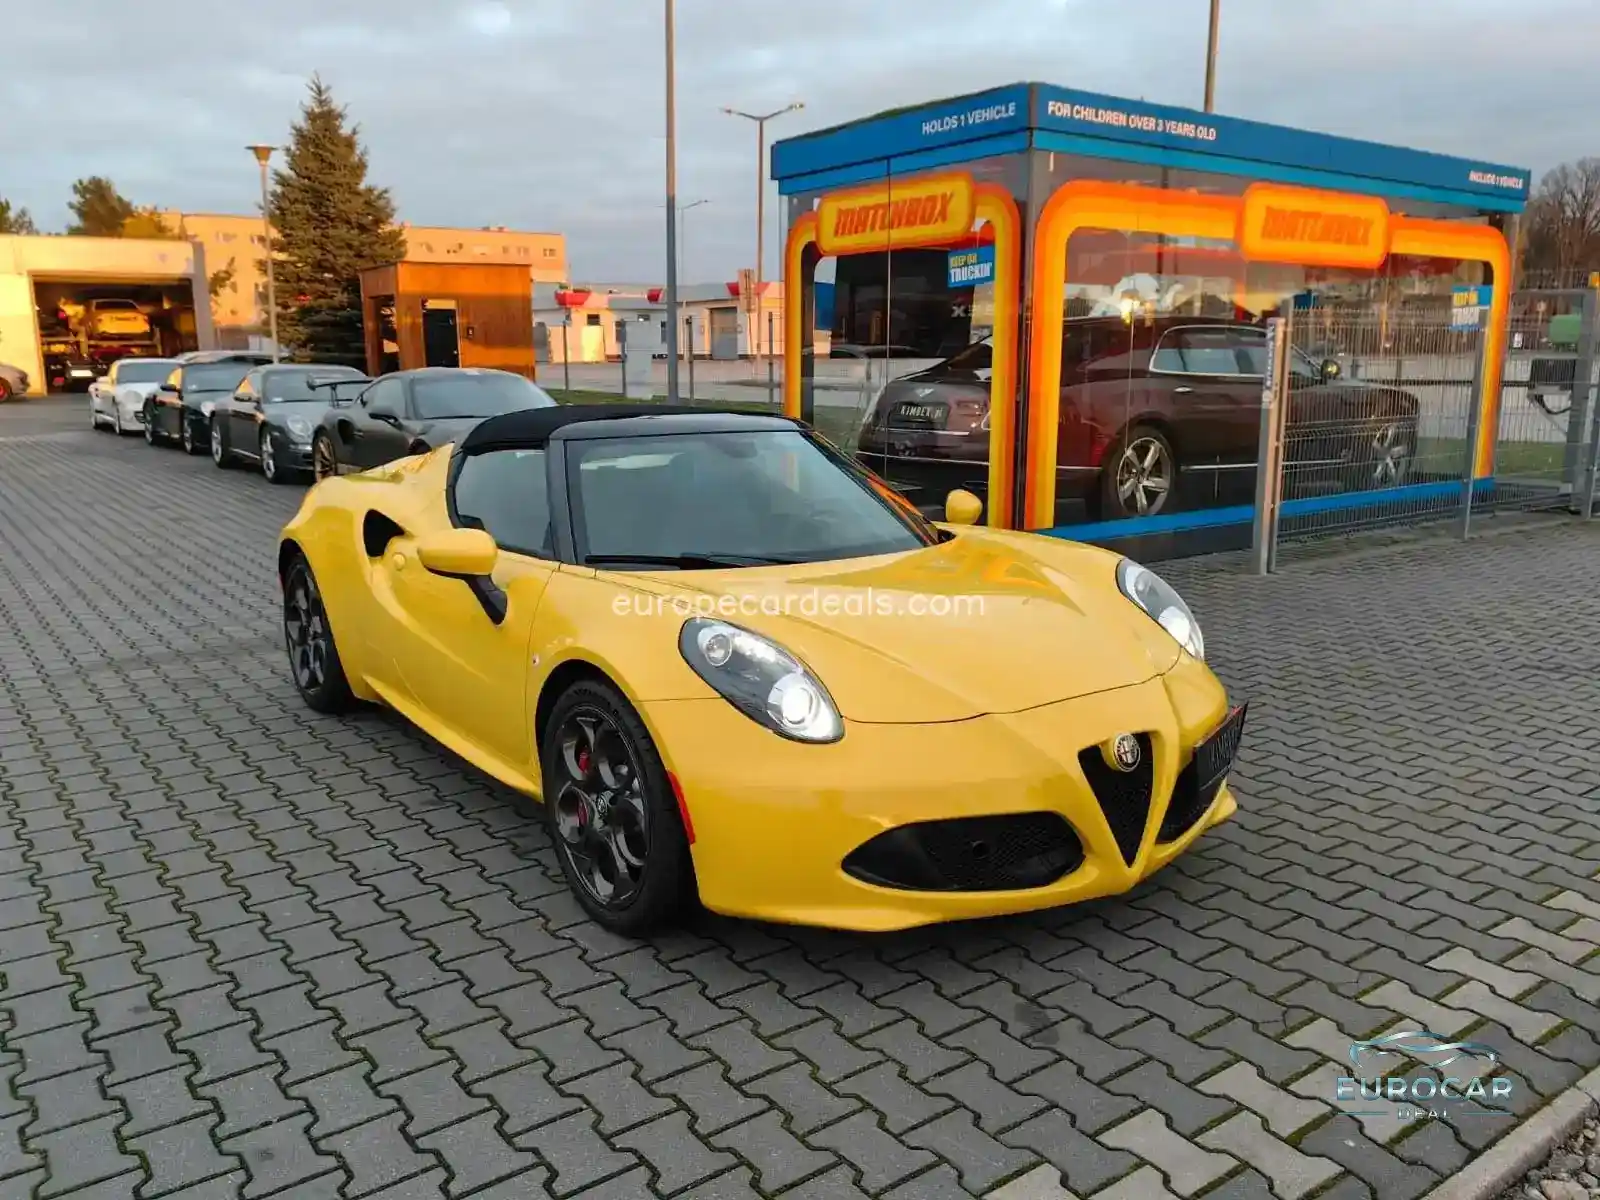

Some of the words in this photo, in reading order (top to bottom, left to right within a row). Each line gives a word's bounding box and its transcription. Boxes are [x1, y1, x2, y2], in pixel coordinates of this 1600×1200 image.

[921, 118, 958, 136] HOLDS
[959, 115, 966, 131] 1
[967, 102, 1016, 125] VEHICLE
[1047, 101, 1071, 117] FOR
[1072, 105, 1126, 126] CHILDREN
[1128, 114, 1156, 131] OVER
[1157, 120, 1163, 132] 3
[1164, 120, 1195, 137] YEARS
[1196, 126, 1216, 141] OLD
